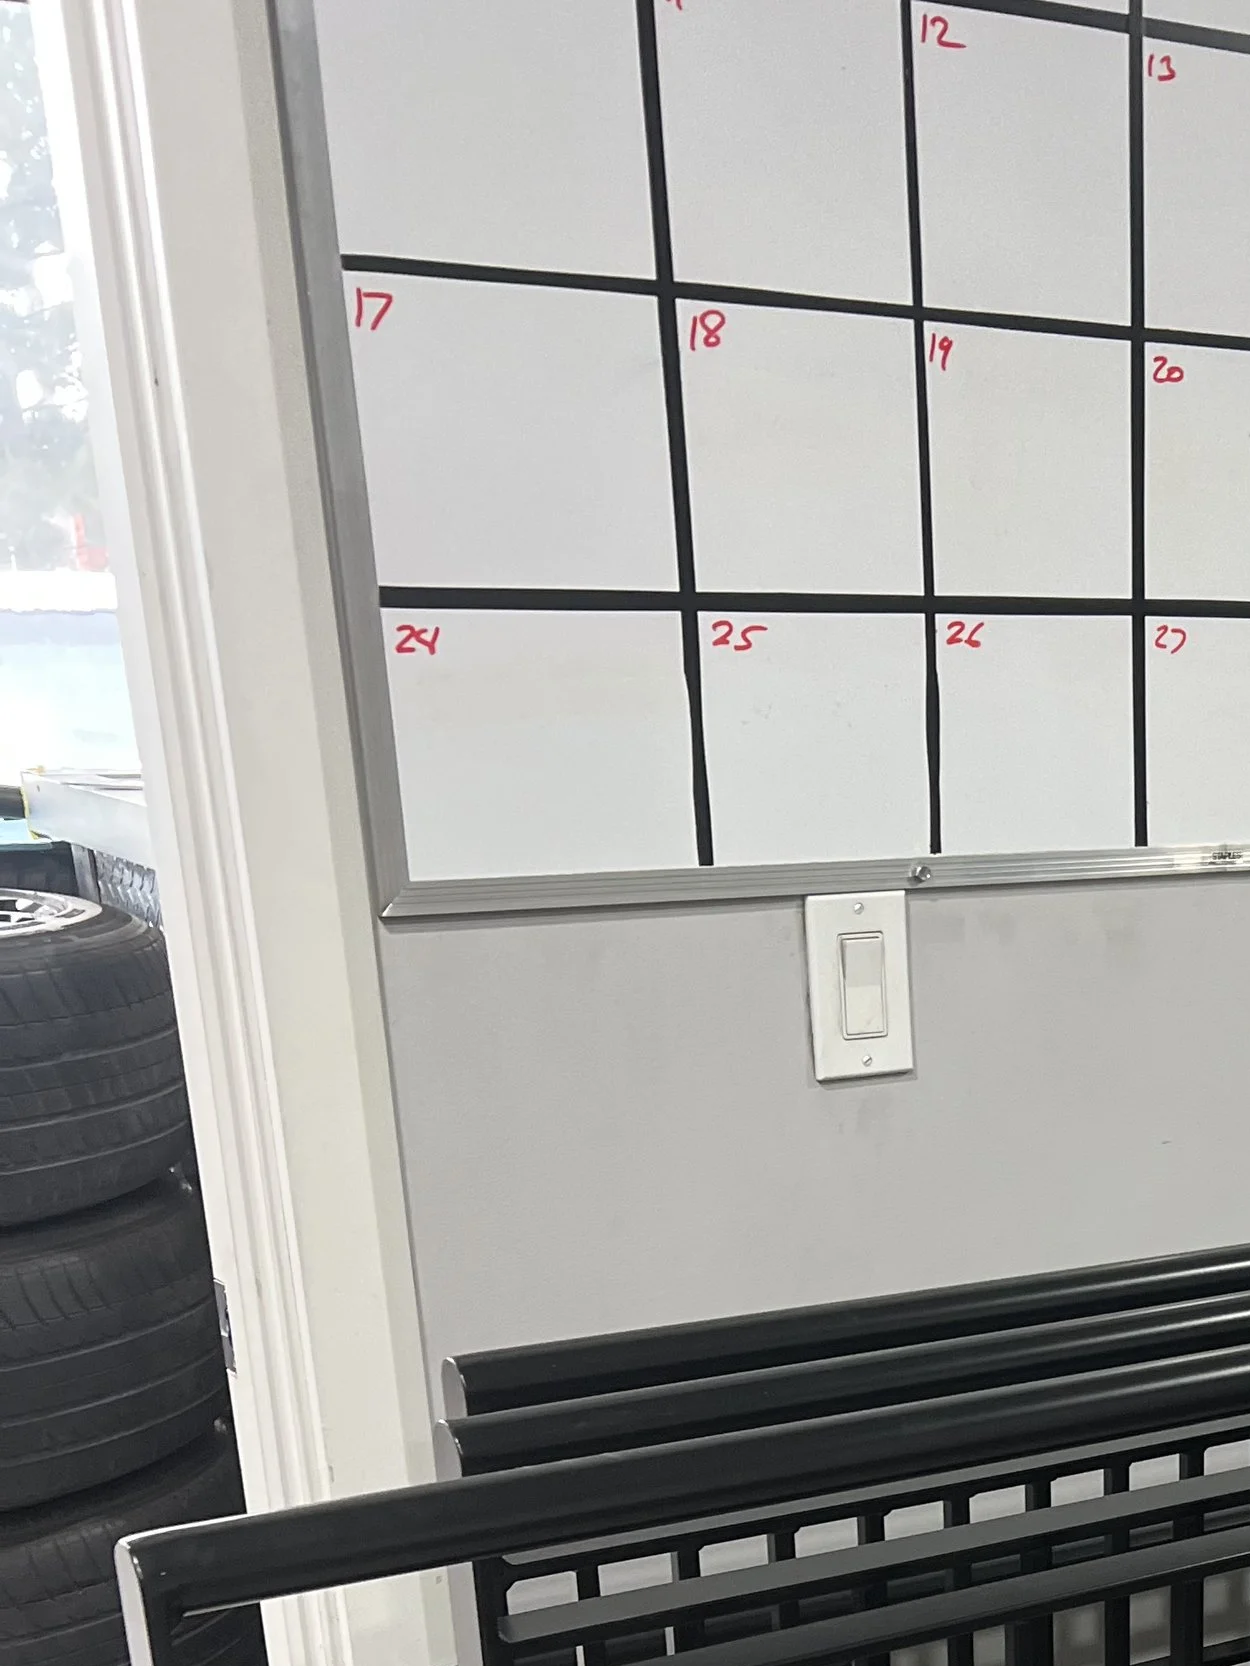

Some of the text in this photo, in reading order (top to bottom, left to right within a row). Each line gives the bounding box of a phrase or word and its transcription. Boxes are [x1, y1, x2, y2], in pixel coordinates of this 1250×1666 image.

[920, 14, 965, 49] 12
[1147, 54, 1176, 82] 13
[354, 287, 394, 331] 17
[689, 309, 726, 352] 18
[929, 333, 954, 371] 19
[1152, 355, 1185, 385] 20
[394, 623, 441, 655] 24
[711, 619, 768, 653] 25
[945, 620, 986, 649] 26
[1154, 624, 1188, 654] 27
